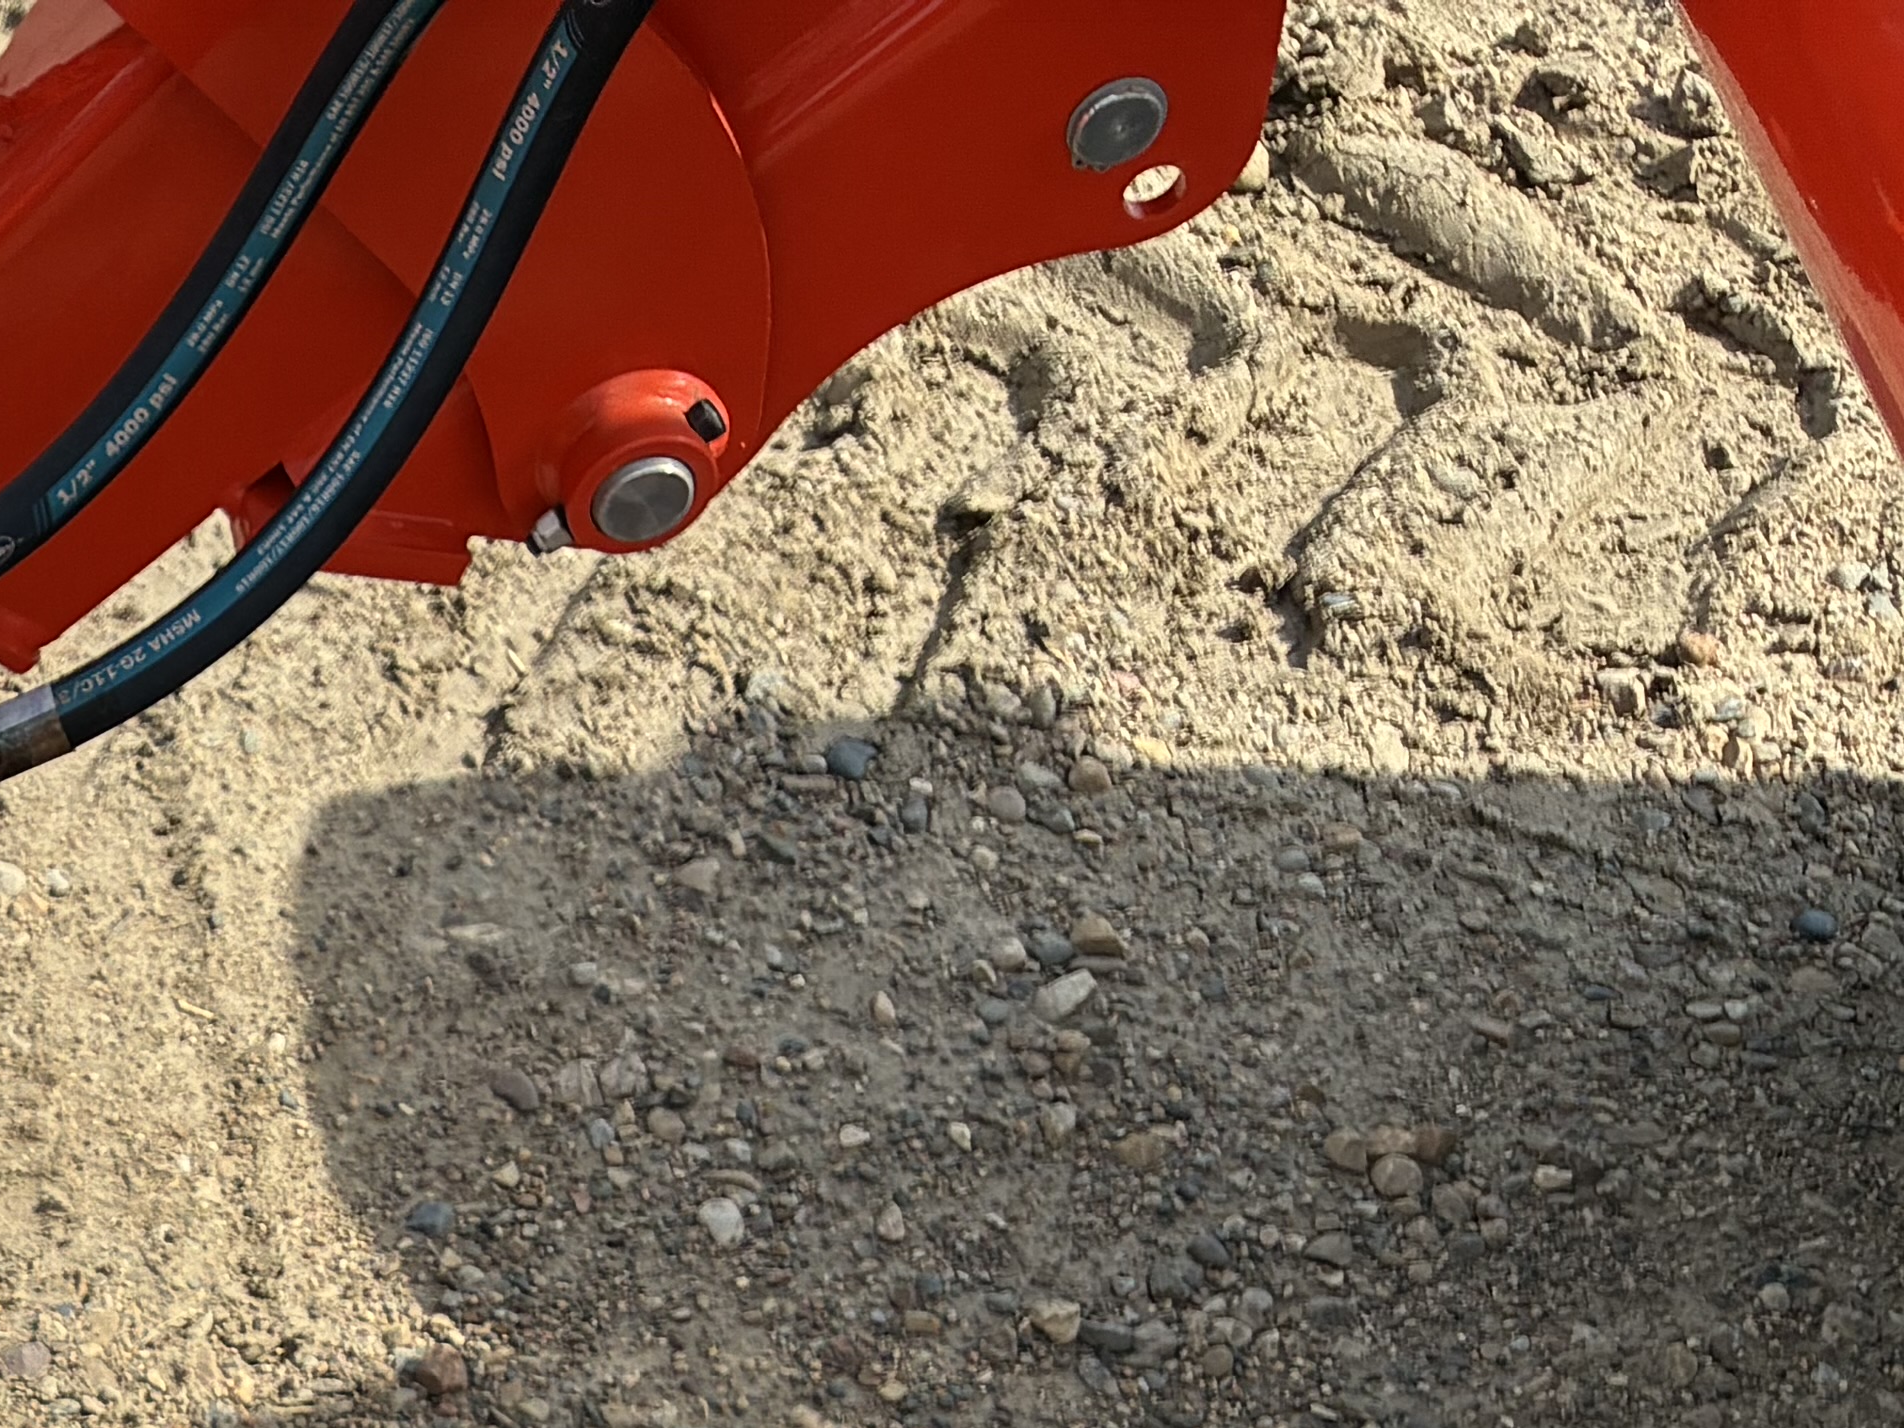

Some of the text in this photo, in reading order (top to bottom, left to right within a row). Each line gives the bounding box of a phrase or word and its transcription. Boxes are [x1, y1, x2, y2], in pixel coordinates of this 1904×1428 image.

[509, 92, 541, 145] 4000
[491, 141, 514, 182] psi
[105, 407, 150, 457] 4000
[148, 372, 178, 411] psi
[146, 608, 202, 652] MSHA
